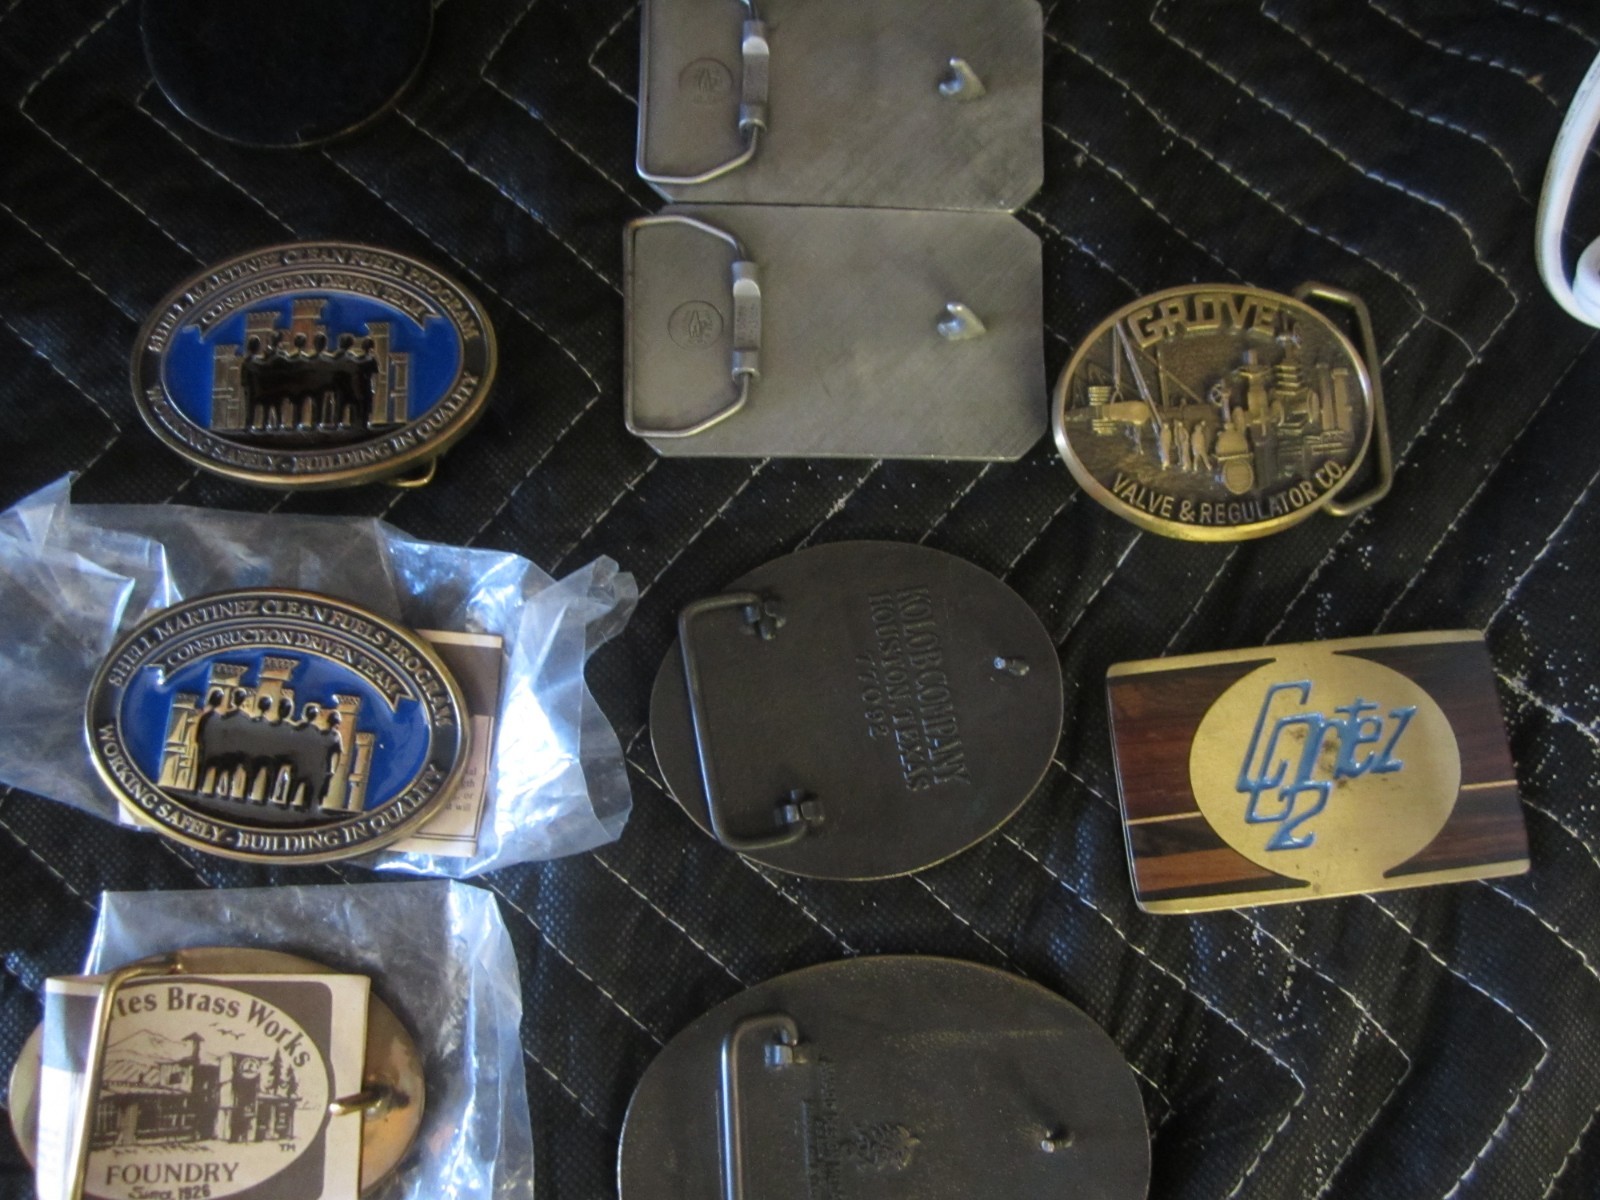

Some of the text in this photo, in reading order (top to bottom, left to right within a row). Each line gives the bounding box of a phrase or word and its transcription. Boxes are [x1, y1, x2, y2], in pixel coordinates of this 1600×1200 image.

[202, 273, 318, 324] CONSTRUCTION
[405, 268, 480, 340] PROGRAM
[1126, 294, 1281, 348] GROVE
[292, 443, 389, 474] BUILDING
[390, 431, 418, 450] IN
[416, 371, 479, 439] QUALITY
[1112, 460, 1347, 524] VALVE & REGULATOR CO.
[108, 599, 453, 728] SHELL MARTINEZ CLEAN FUELS PROGRAM
[167, 629, 402, 696] CONSTRUCTION DRIVEN TEAM
[855, 651, 890, 741] 77092
[892, 708, 930, 792] TEXAS
[914, 670, 971, 785] COMPANY
[98, 724, 157, 810] WORKING
[154, 802, 225, 844] SAFELY
[238, 829, 339, 852] BUILDING
[345, 819, 367, 843] IN
[370, 763, 445, 833] QUALITY
[111, 986, 312, 1068] tes Brass Works
[105, 1161, 240, 1186] FOUNDRY
